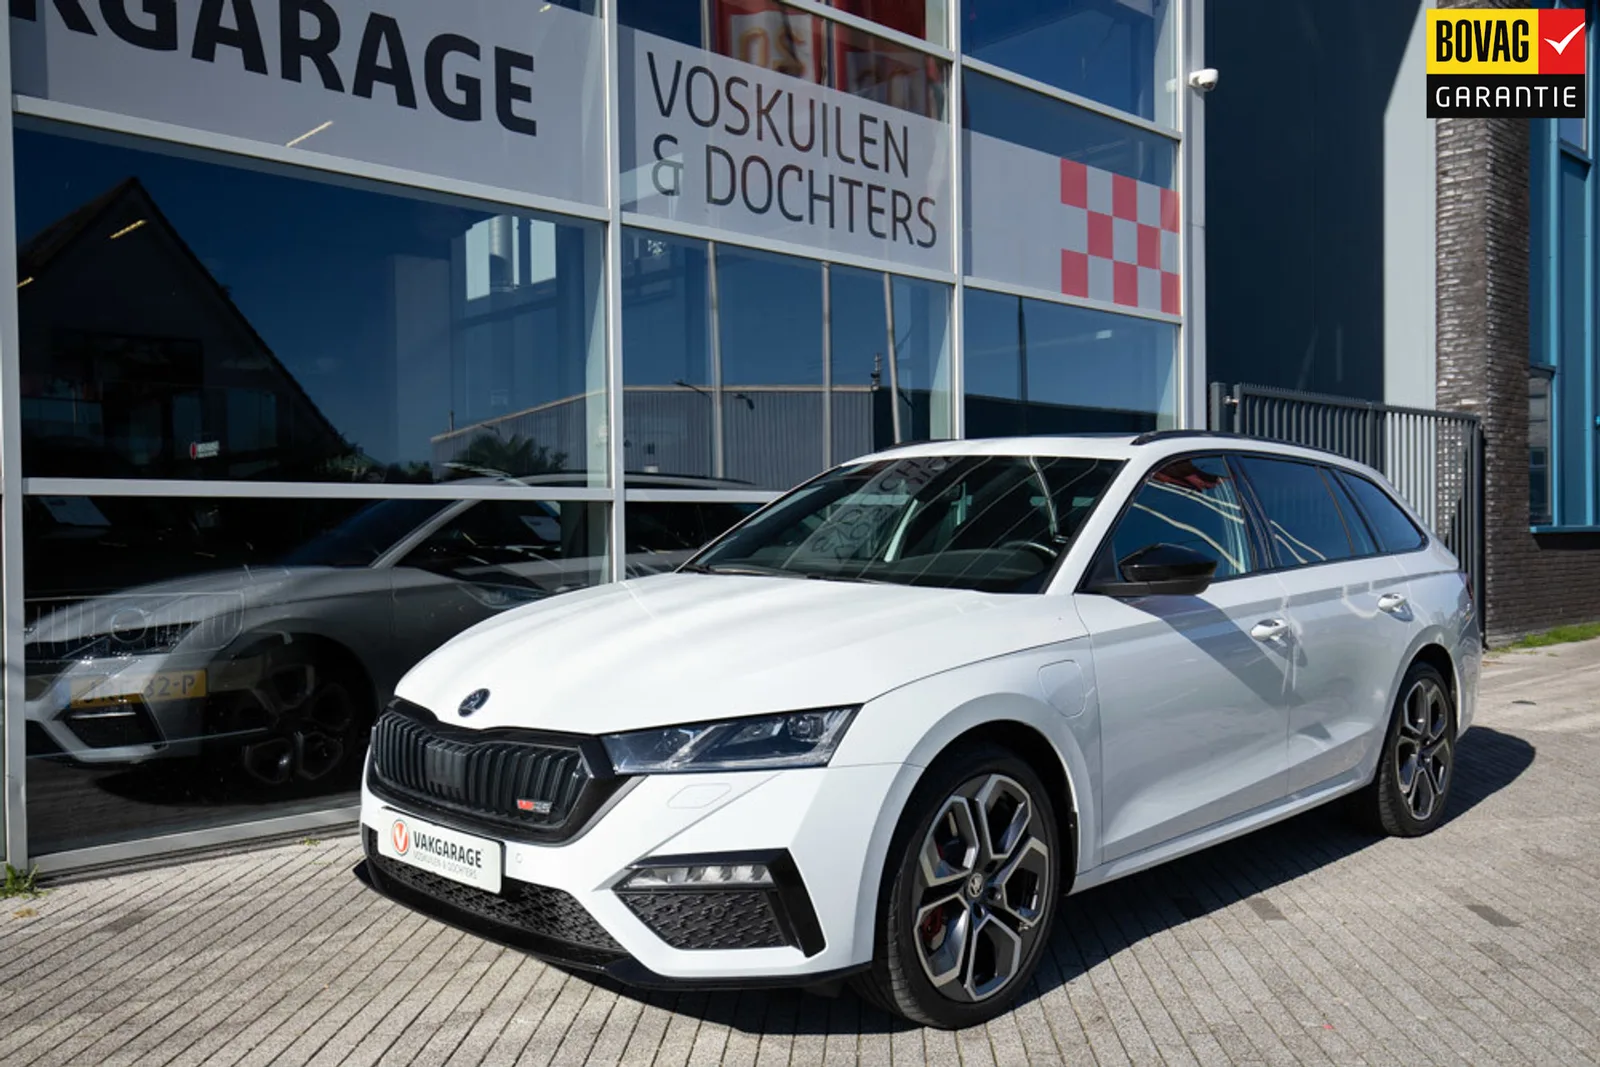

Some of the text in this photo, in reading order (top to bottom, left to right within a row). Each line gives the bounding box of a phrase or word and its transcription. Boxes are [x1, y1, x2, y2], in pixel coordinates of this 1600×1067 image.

[10, 0, 537, 137] GARAGE
[647, 52, 909, 178] VOSKUILEN
[652, 134, 937, 248] & DOCHTERS
[413, 831, 482, 868] VAKGARAGE
